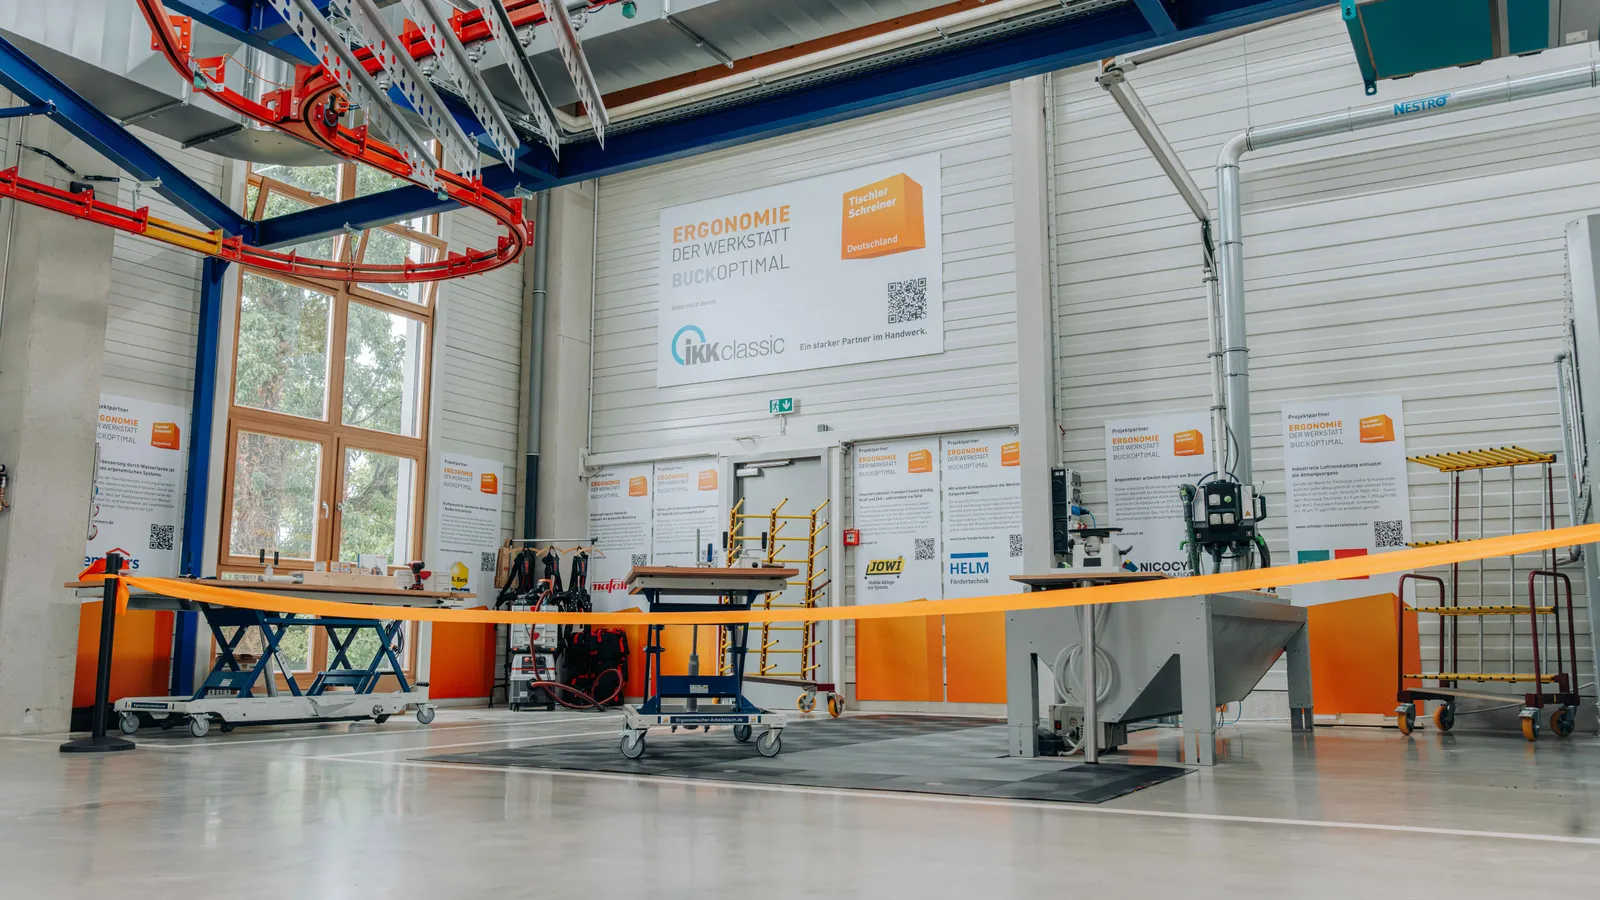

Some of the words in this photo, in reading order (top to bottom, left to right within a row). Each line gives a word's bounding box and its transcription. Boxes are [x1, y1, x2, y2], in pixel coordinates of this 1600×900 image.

[1393, 95, 1449, 116] NESTRO
[848, 188, 888, 206] Tischler
[848, 198, 897, 218] Schreiner
[673, 204, 790, 244] ERGONOMIE
[672, 244, 700, 262] DER
[704, 226, 790, 256] WERKSTATT
[847, 234, 898, 252] Deutschland
[672, 254, 790, 288] BUCKOPTIMAL
[800, 343, 812, 351] Ein
[812, 339, 840, 350] starker
[842, 336, 872, 345] Partner
[884, 328, 928, 340] Handwerk.
[100, 414, 138, 426] GONOMIE
[1288, 412, 1330, 420] Projektpartner
[102, 423, 138, 434] WERKSTATT
[1289, 420, 1343, 432] ERGONOMIE
[97, 432, 136, 444] CKOPTIMAL
[1112, 434, 1160, 444] ERGONOMIE
[1304, 429, 1343, 438] WERKSTATT
[1112, 444, 1124, 452] DER
[1126, 442, 1160, 450] WERKSTATT
[1290, 438, 1344, 448] BUCKOPTIMAL
[948, 446, 988, 456] ERGONOMIE
[1113, 452, 1160, 460] BUCKOPTIMAL
[858, 454, 897, 463] ERGONOMIE
[948, 462, 989, 470] BUCKOPTIMAL
[858, 469, 896, 477] BUCKOPTIMAL
[870, 560, 902, 572] JOWI
[950, 562, 988, 574] HELM
[1140, 562, 1188, 572] NICOCY
